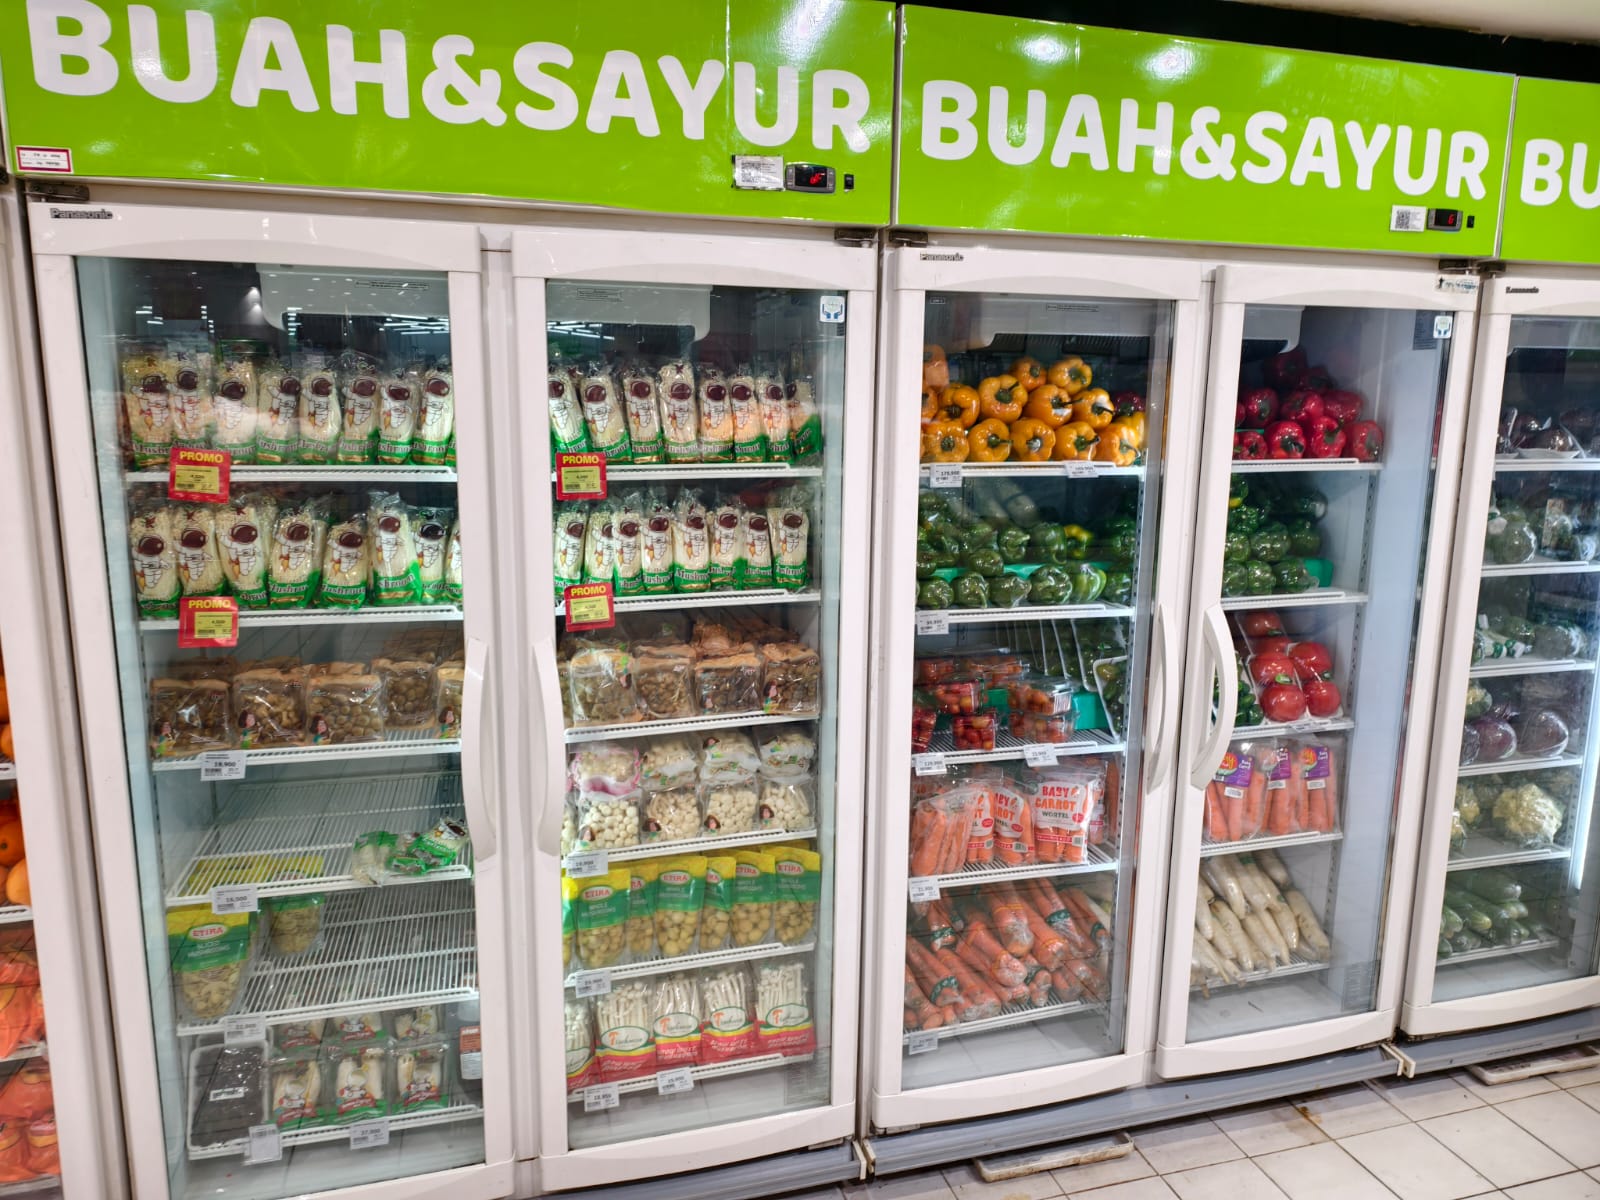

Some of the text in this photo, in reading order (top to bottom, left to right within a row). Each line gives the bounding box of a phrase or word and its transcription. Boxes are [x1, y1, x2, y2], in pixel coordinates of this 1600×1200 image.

[27, 0, 871, 153] BUAH&SAYUR
[921, 80, 1489, 200] BUAH&SAYUR
[50, 208, 113, 219] Panasonic
[179, 451, 224, 463] PROMO
[562, 455, 599, 464] PROMO
[571, 586, 606, 596] PROMO
[188, 600, 231, 608] PROMO
[1042, 786, 1069, 798] BABY
